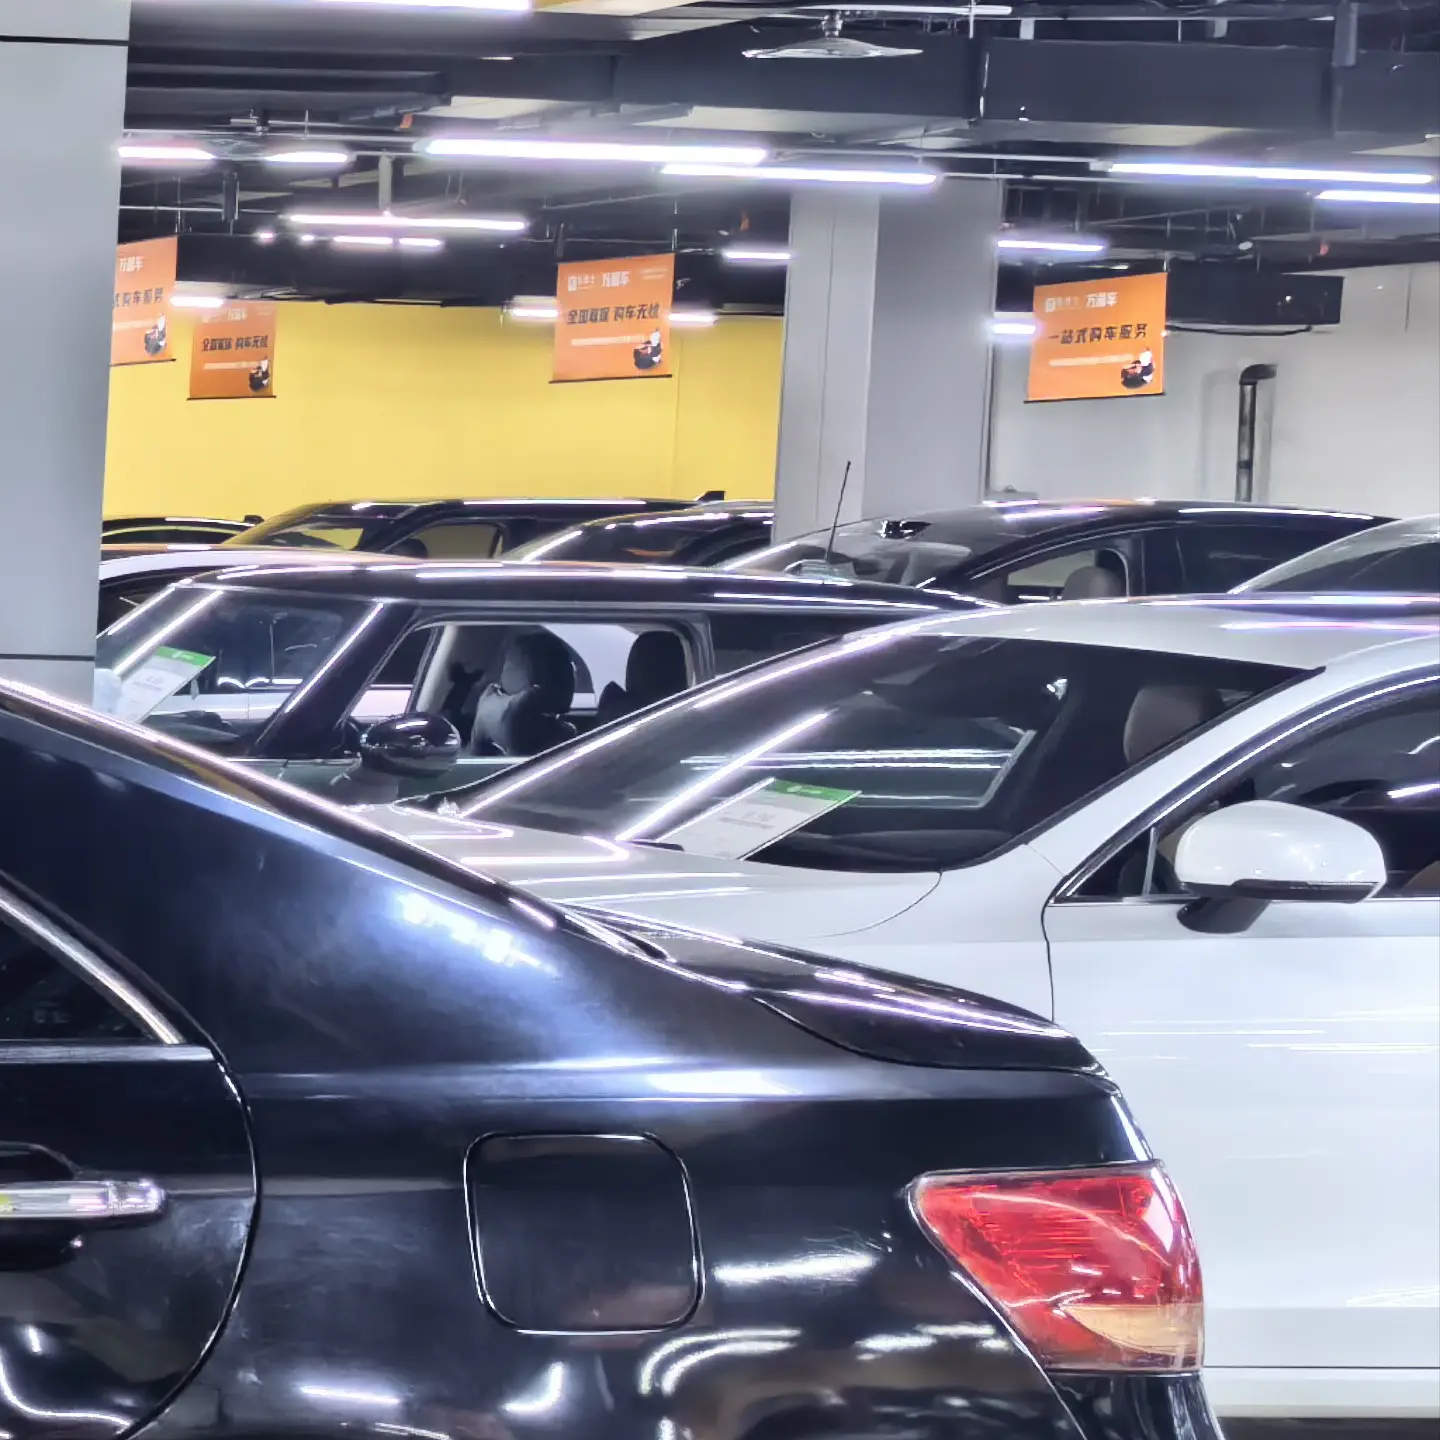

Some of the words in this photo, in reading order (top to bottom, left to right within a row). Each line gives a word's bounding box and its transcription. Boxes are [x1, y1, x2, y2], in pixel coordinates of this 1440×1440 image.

[1048, 323, 1148, 344] 一站式购车服务
